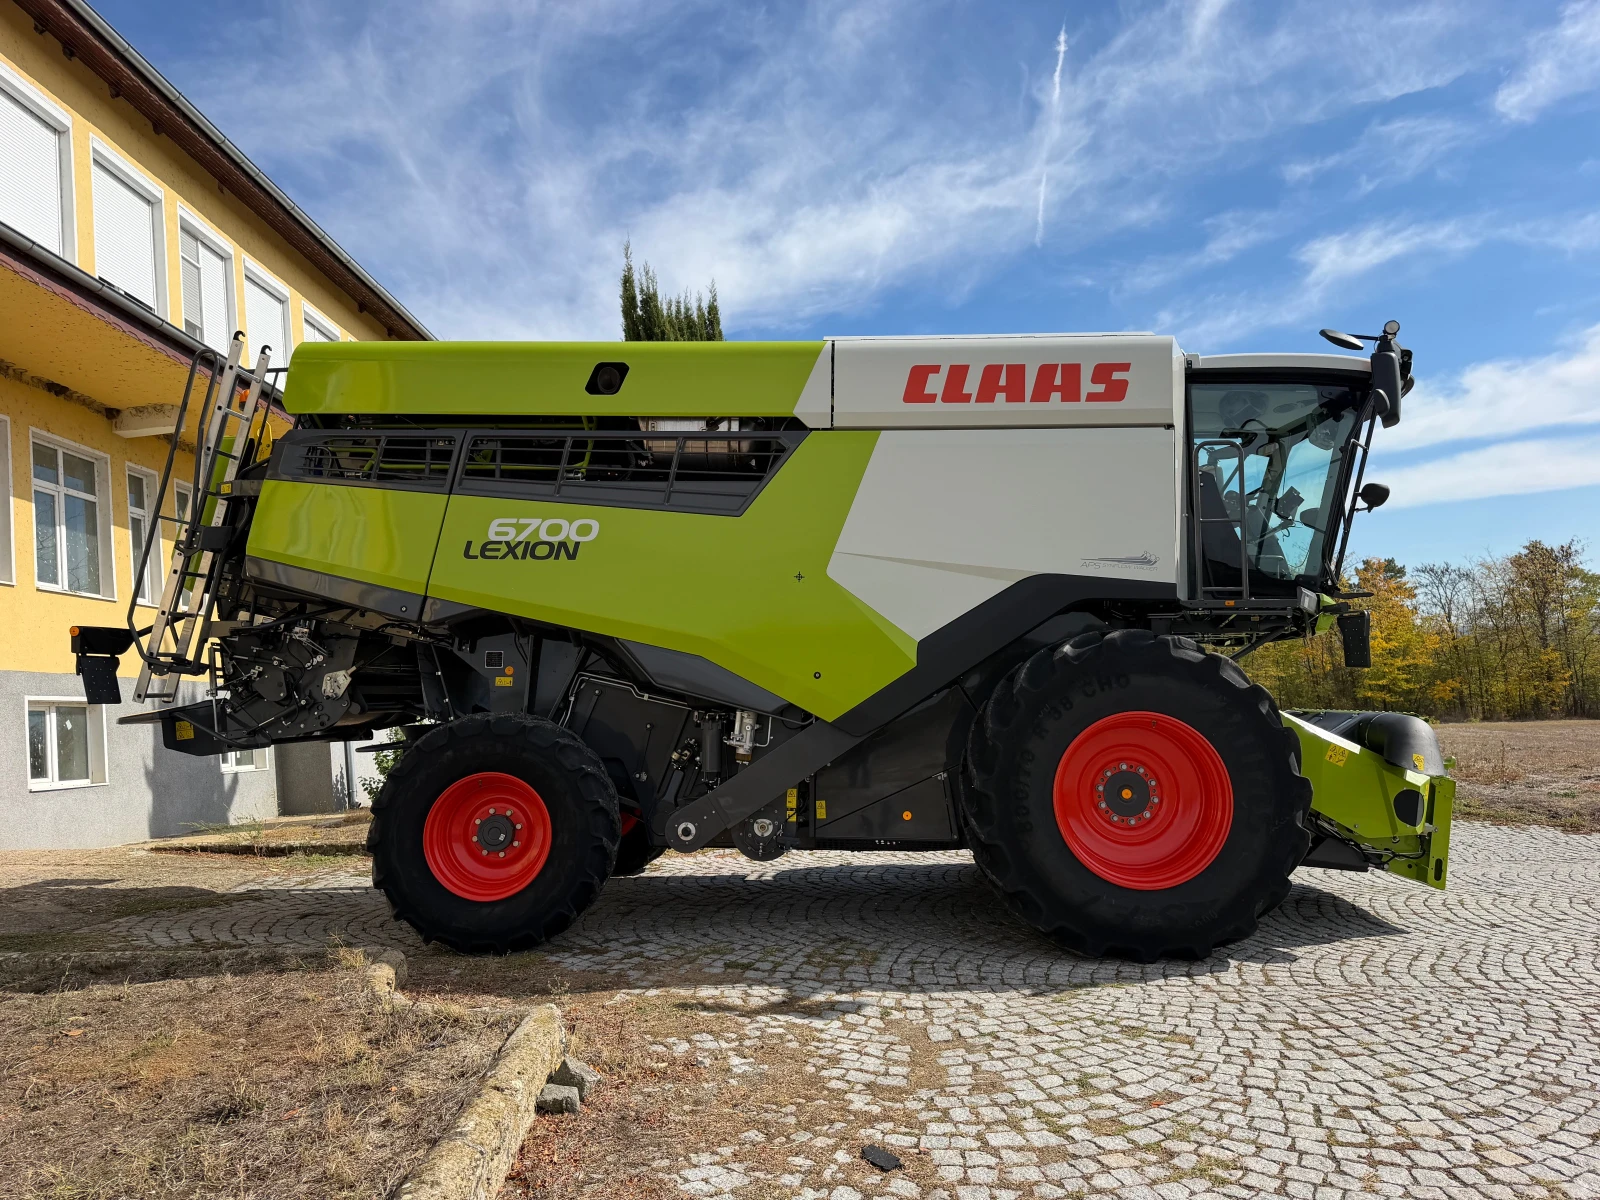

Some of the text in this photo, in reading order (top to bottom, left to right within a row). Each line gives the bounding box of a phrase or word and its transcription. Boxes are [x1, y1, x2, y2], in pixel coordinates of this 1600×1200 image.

[903, 362, 1131, 404] CLAAS
[487, 517, 600, 542] 6700
[463, 540, 581, 561] LEXION
[1080, 561, 1101, 570] APS
[1048, 695, 1074, 721] 38
